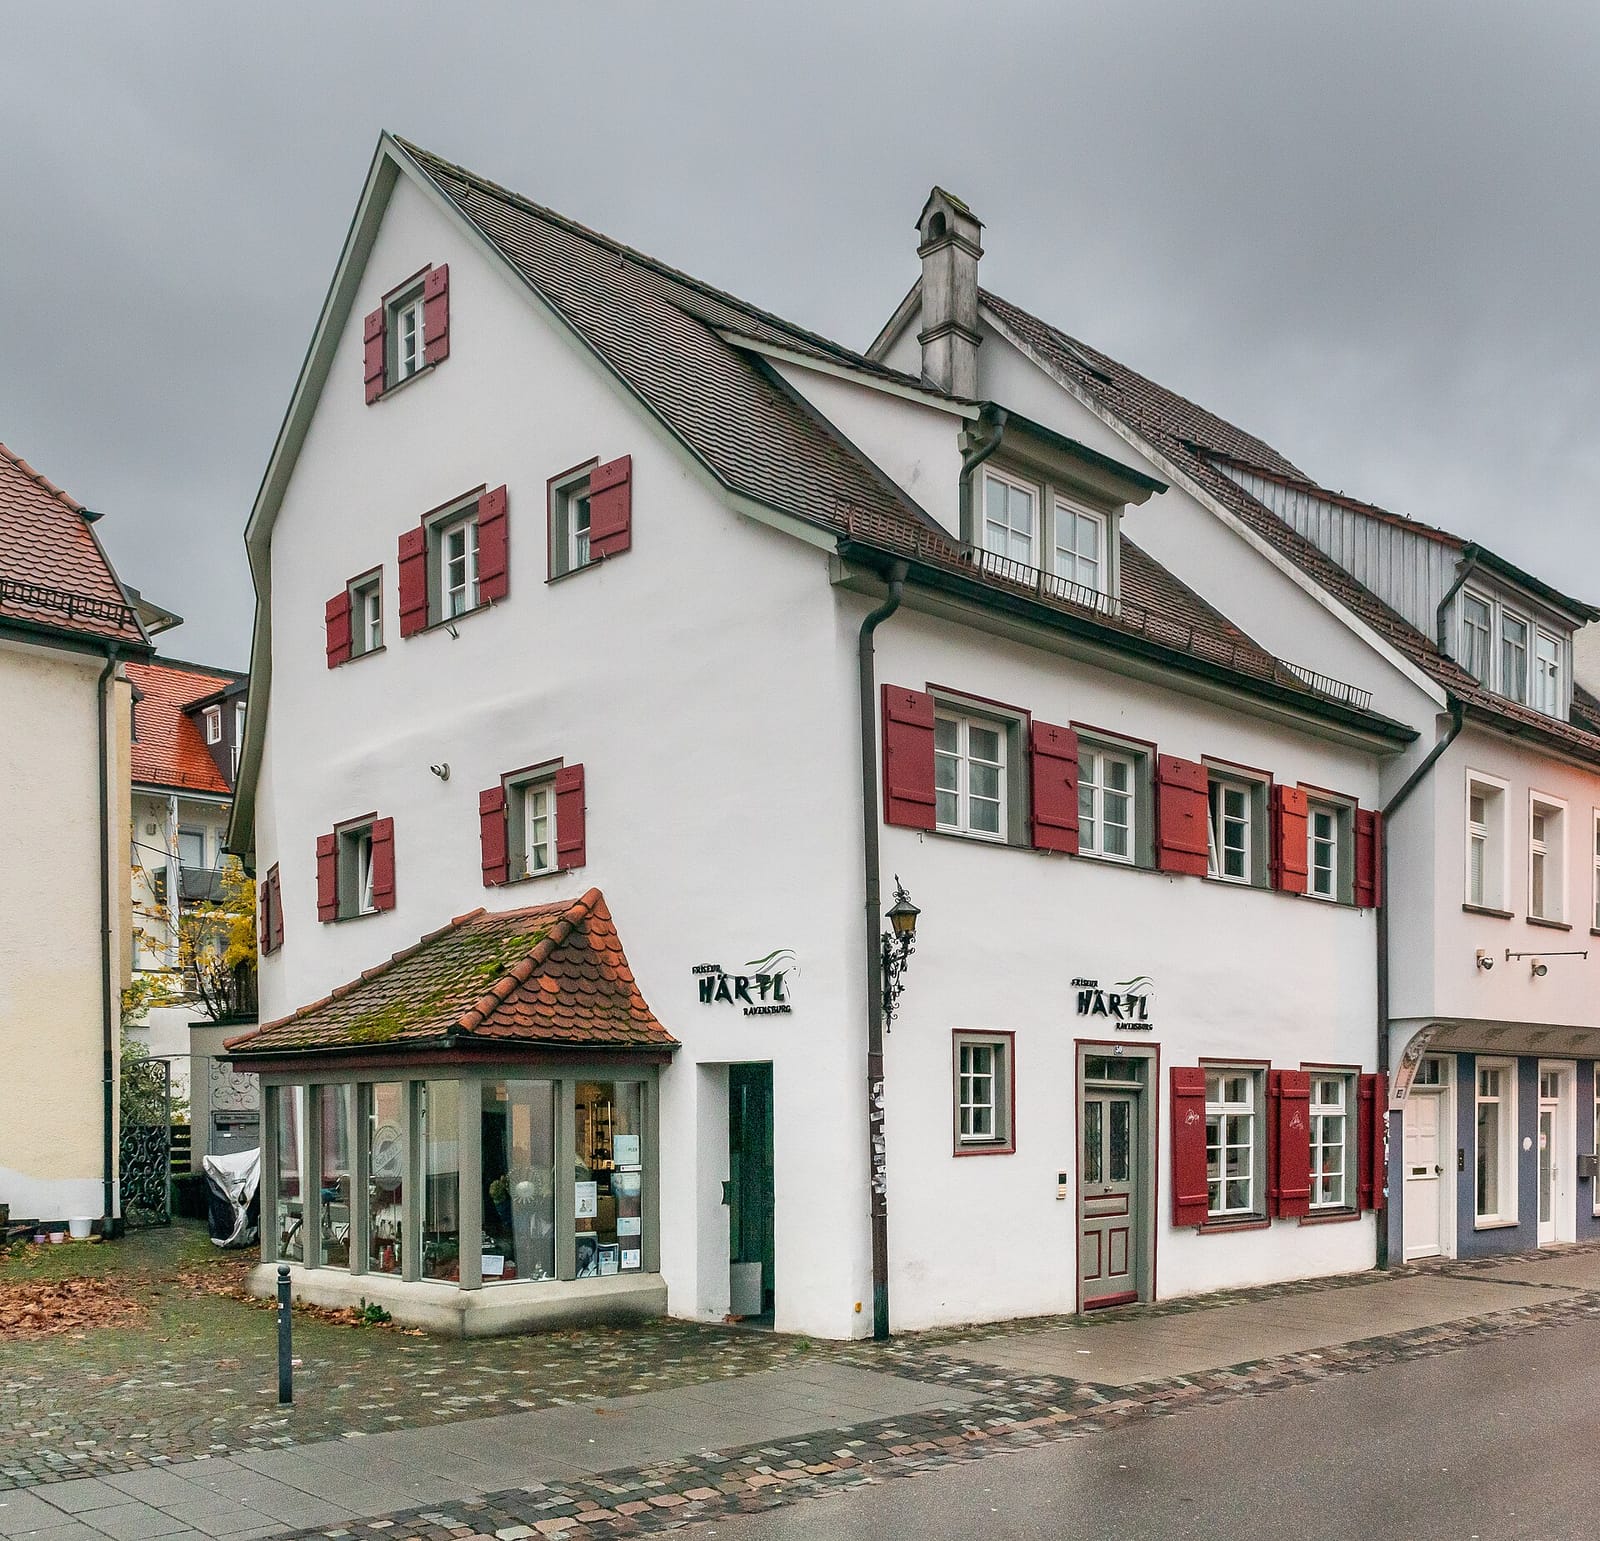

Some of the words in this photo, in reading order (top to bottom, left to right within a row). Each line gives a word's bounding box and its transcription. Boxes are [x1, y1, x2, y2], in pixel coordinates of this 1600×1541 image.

[698, 972, 786, 1005] HÄRTL
[743, 1004, 792, 1016] RAVENSBURG
[1078, 989, 1149, 1020] HÄRTL
[1115, 1022, 1154, 1031] RAVENSBURG
